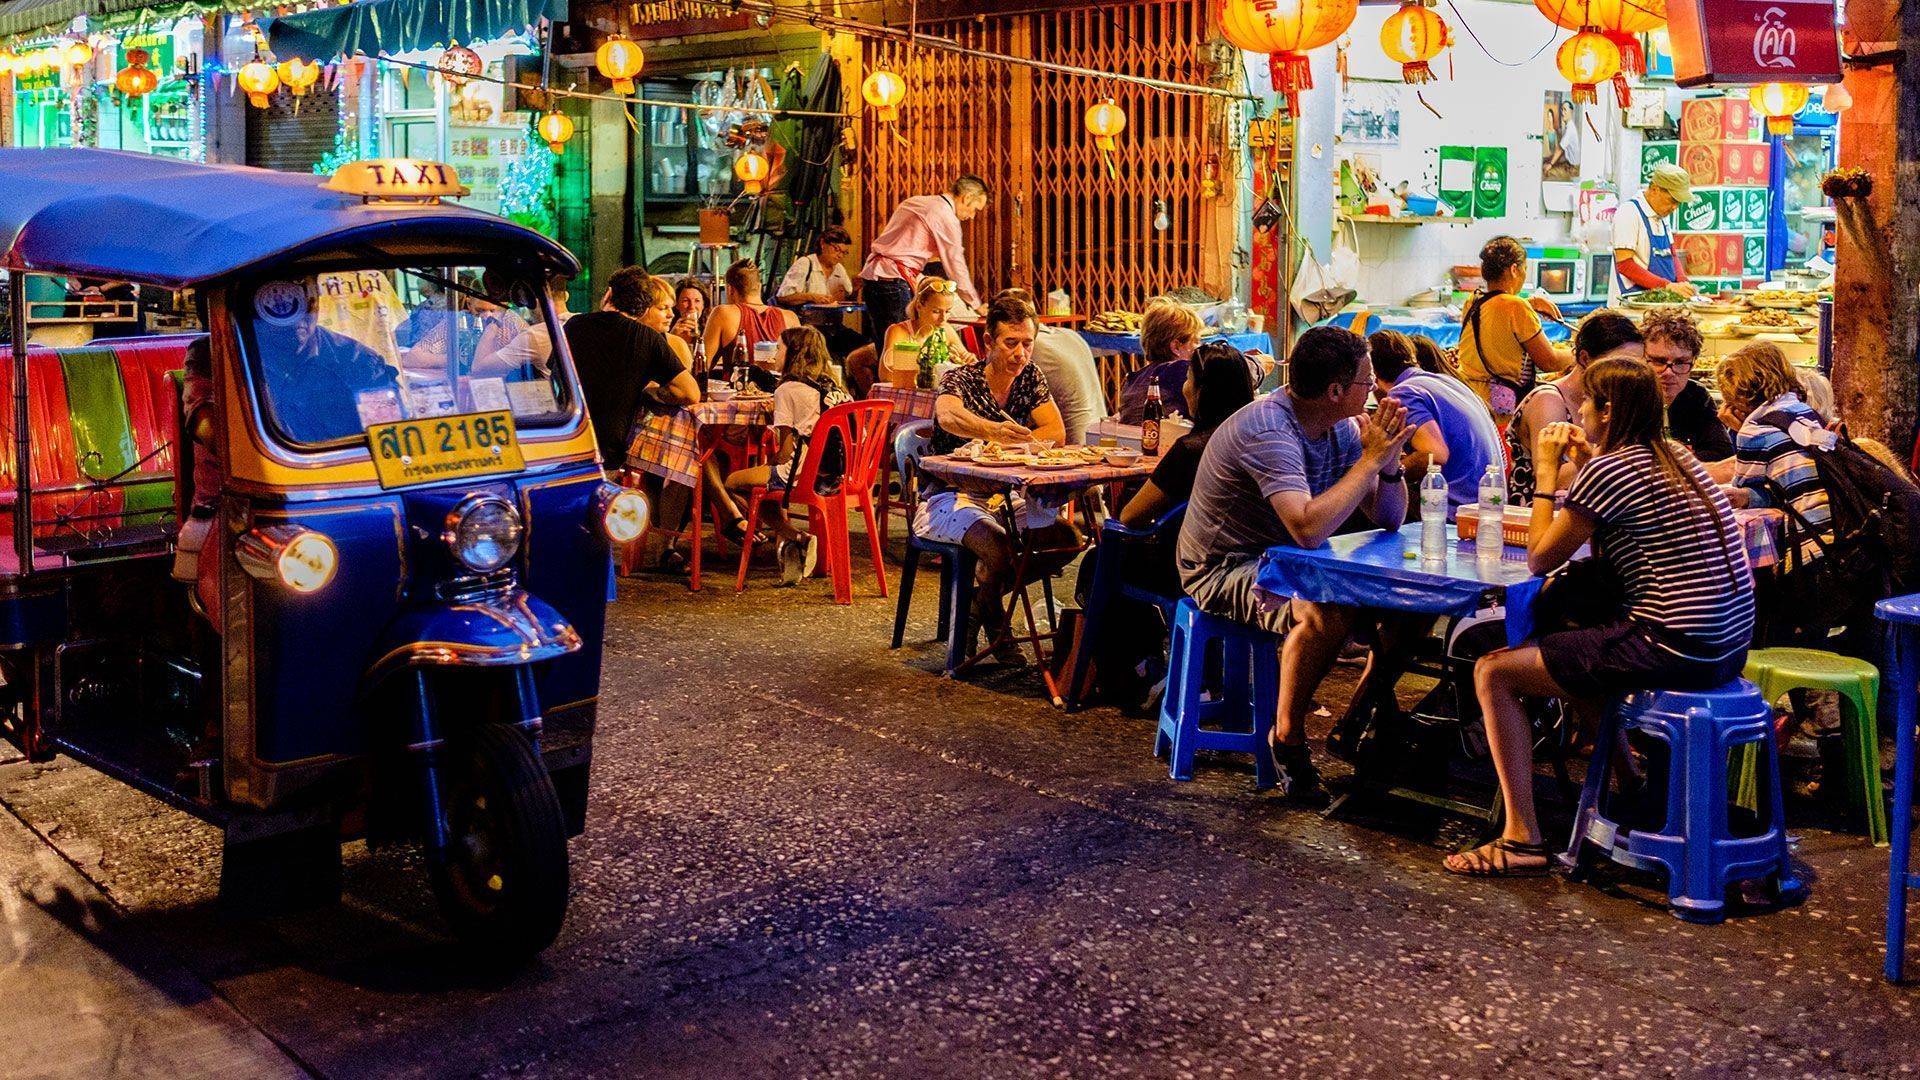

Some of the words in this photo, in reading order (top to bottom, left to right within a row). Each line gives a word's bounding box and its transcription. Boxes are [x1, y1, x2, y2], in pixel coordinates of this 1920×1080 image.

[367, 165, 448, 185] TAXI
[1684, 202, 1713, 222] Chang
[435, 415, 510, 453] 2185
[1143, 430, 1158, 439] LEO
